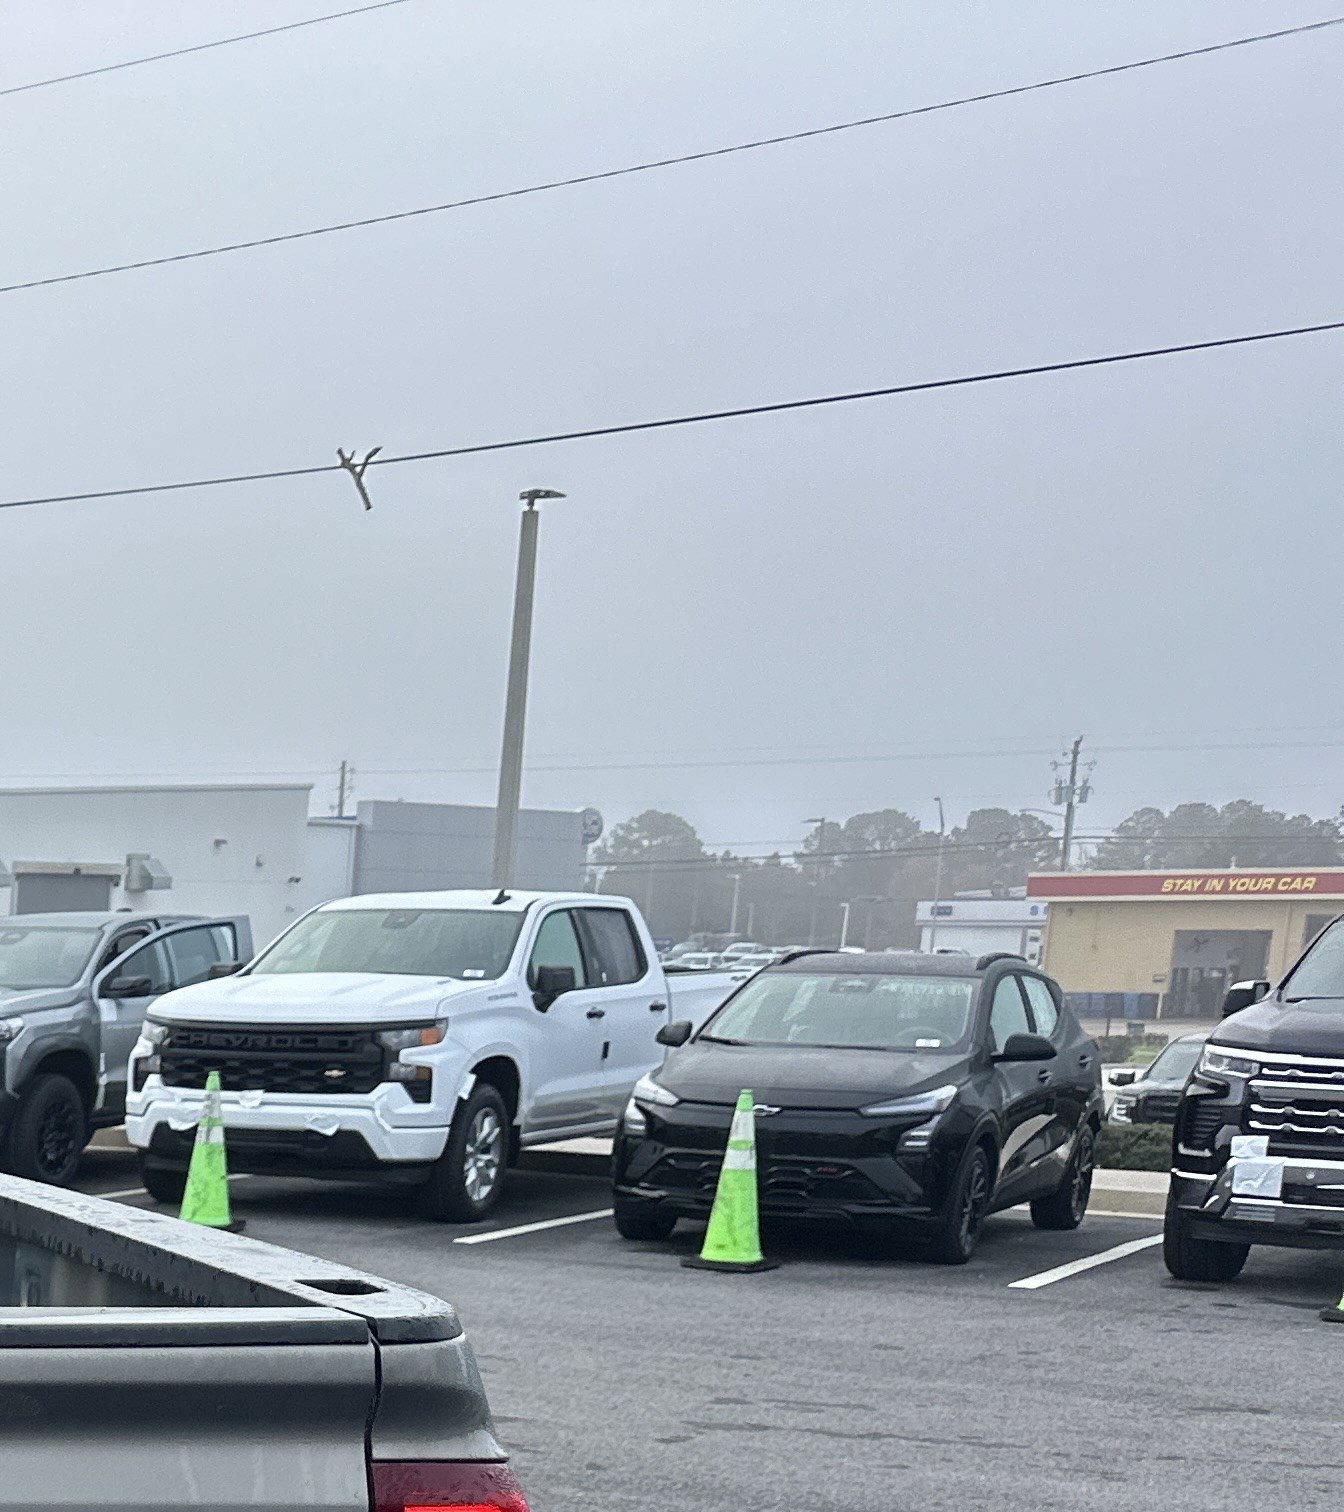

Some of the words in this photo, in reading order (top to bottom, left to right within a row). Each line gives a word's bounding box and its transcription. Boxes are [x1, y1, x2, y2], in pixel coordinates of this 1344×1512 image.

[1161, 878, 1203, 892] STAY
[1204, 878, 1225, 892] IN
[1228, 877, 1276, 892] YOUR
[1277, 876, 1317, 891] CAR
